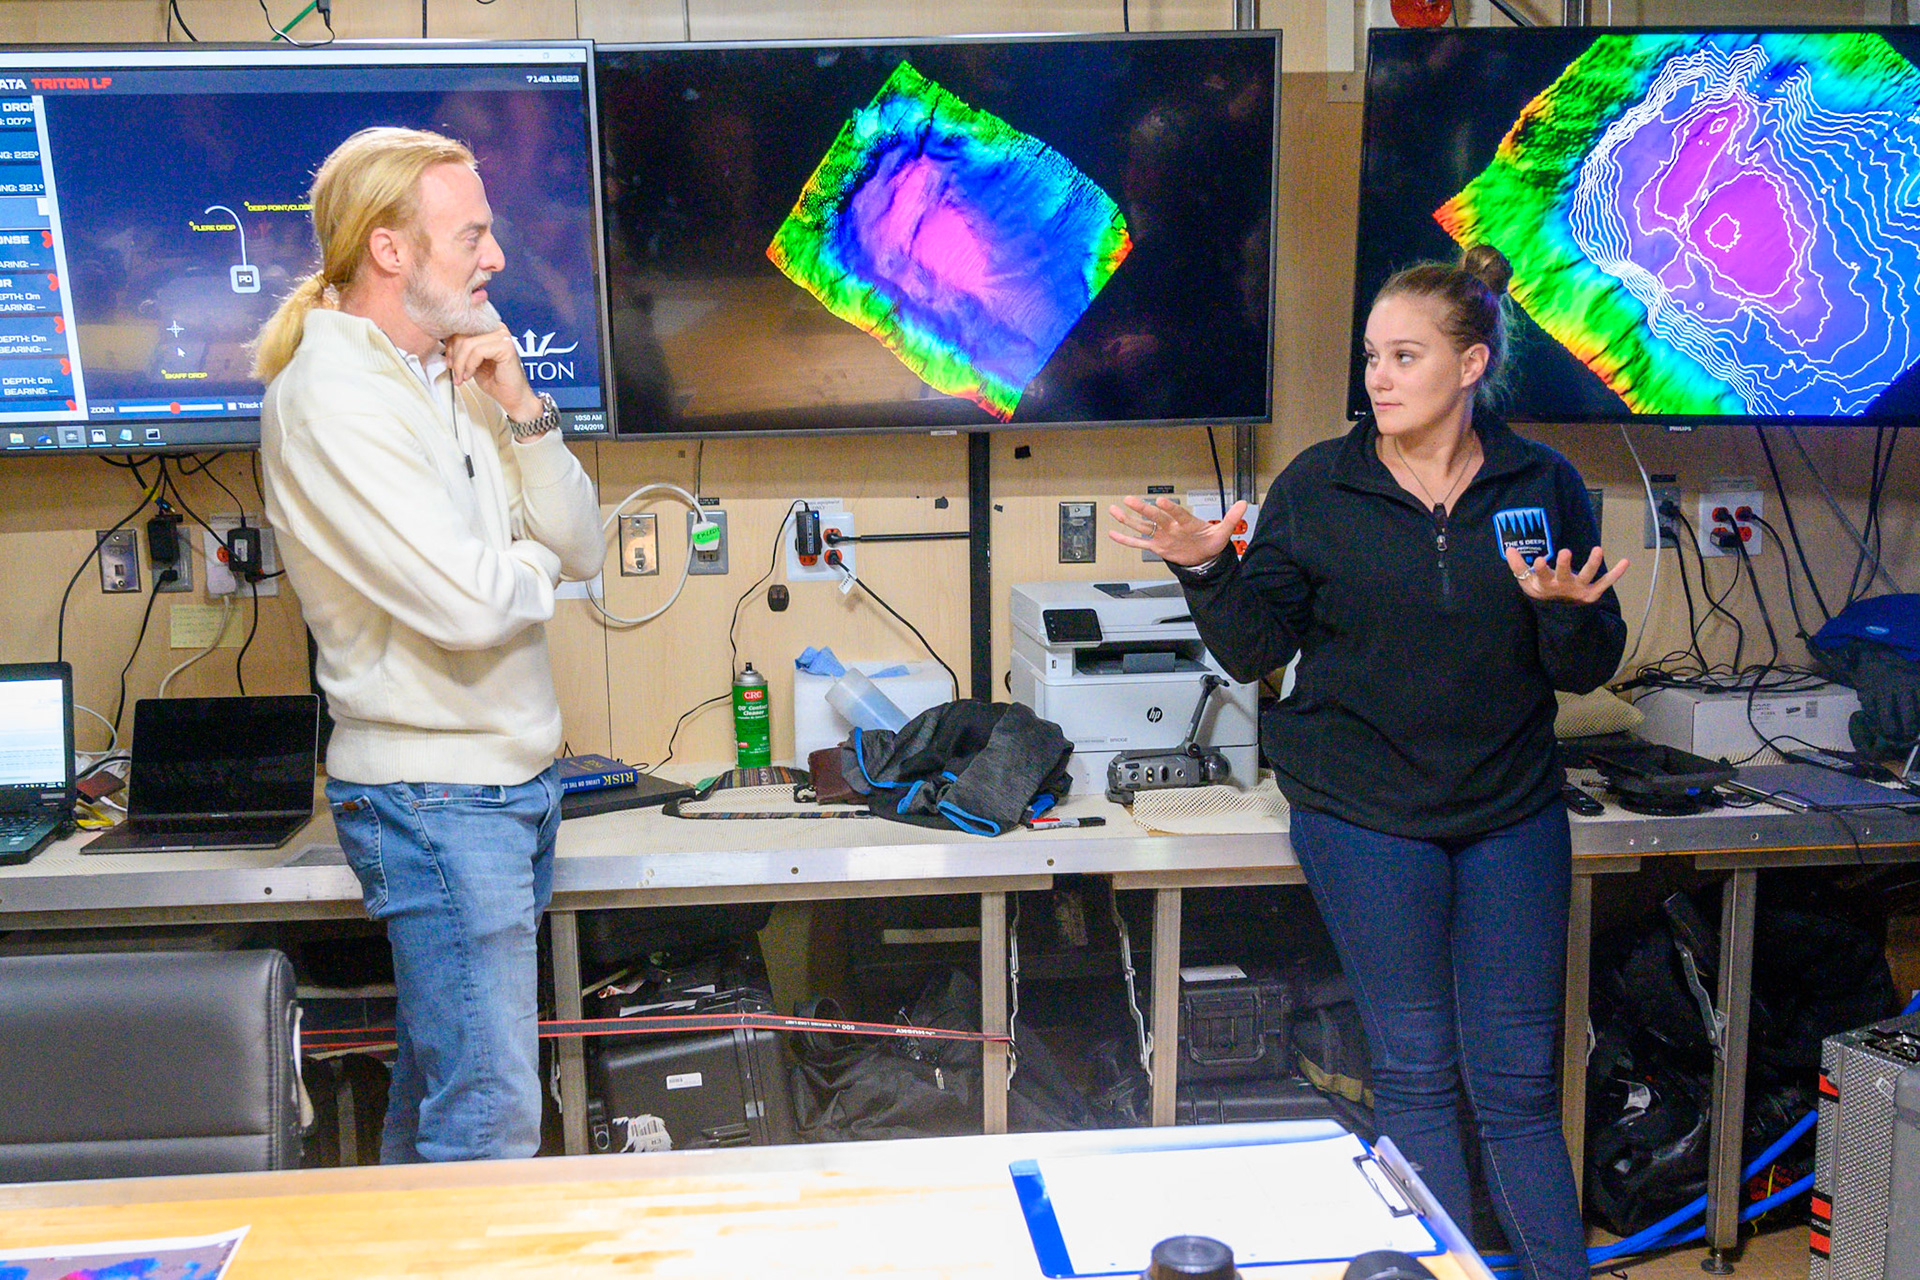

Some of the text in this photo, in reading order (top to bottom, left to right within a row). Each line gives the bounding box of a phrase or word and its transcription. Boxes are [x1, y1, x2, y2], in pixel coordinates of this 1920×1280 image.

[31, 78, 89, 89] TRITON
[521, 361, 574, 381] TON
[4, 387, 48, 396] BEARING:
[90, 406, 115, 414] ZOOM
[237, 401, 260, 409] Track
[744, 690, 763, 700] CRC
[602, 771, 634, 787] RISK
